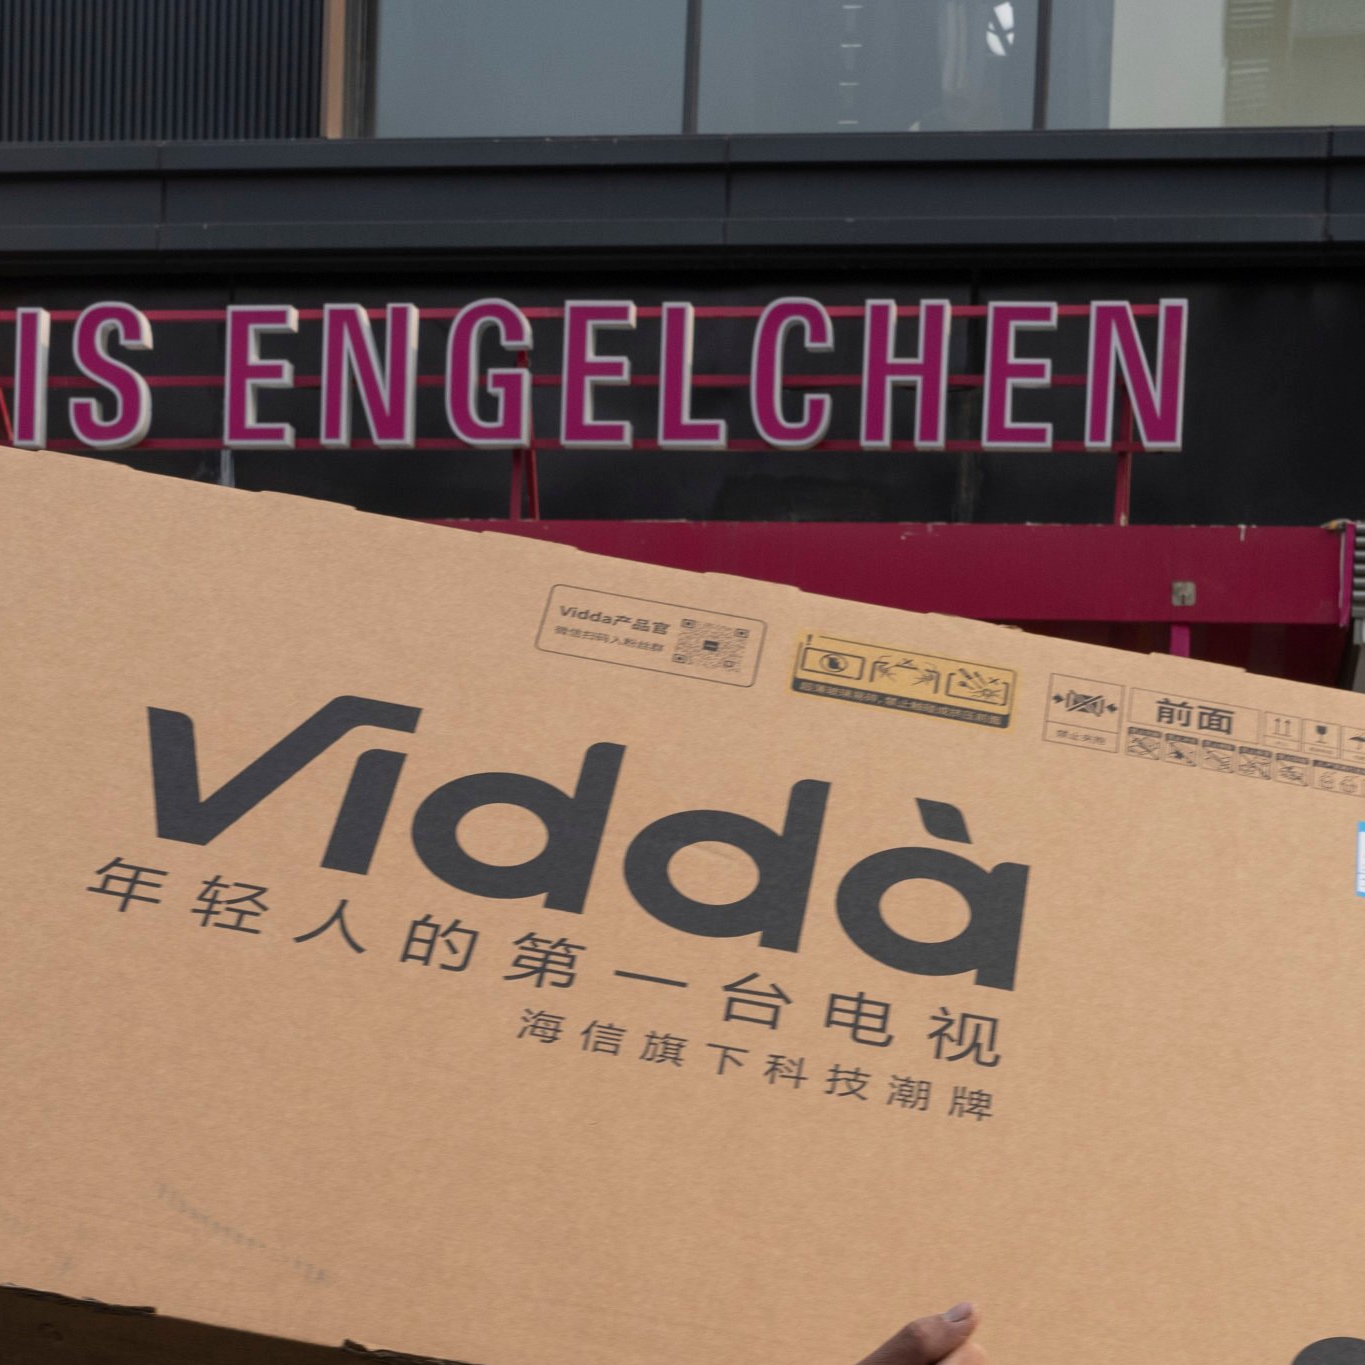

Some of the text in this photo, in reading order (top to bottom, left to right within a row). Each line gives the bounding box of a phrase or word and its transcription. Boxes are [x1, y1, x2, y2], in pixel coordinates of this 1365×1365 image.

[222, 297, 1189, 452] ENGELCHEN
[1155, 697, 1236, 736] 前面
[86, 855, 1004, 1069] 年轻人的第一台电视
[516, 1008, 995, 1123] 海信旗下科技潮牌
